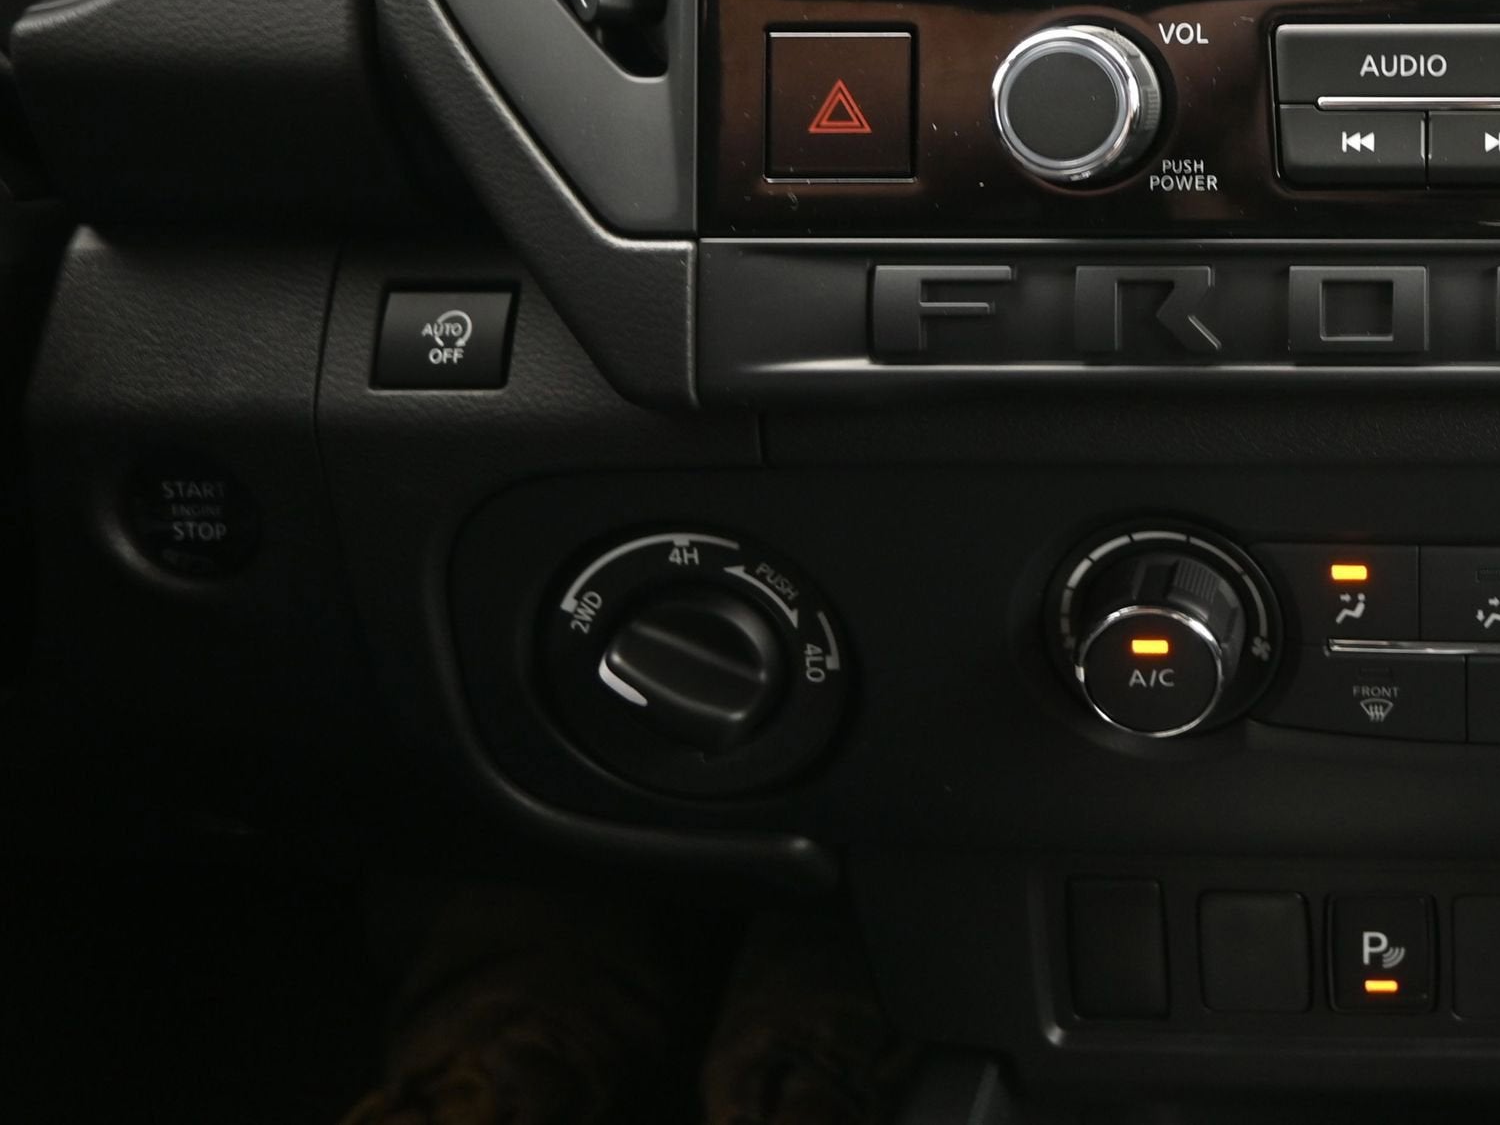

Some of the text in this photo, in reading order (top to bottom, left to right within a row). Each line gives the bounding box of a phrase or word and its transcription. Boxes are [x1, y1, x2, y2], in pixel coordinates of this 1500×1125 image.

[1158, 23, 1209, 45] VOL
[1359, 54, 1448, 78] AUDIO
[1162, 159, 1204, 174] PUSH
[1149, 174, 1219, 192] POWER
[421, 322, 463, 337] AUTO
[428, 347, 464, 365] OFF
[161, 481, 225, 499] START
[172, 520, 227, 542] STOP
[668, 547, 700, 565] 4H
[755, 561, 799, 601] PUSH
[569, 589, 604, 634] 2WD
[803, 641, 826, 684] 4LO
[1128, 668, 1176, 687] A/C
[1352, 686, 1400, 697] FRONT
